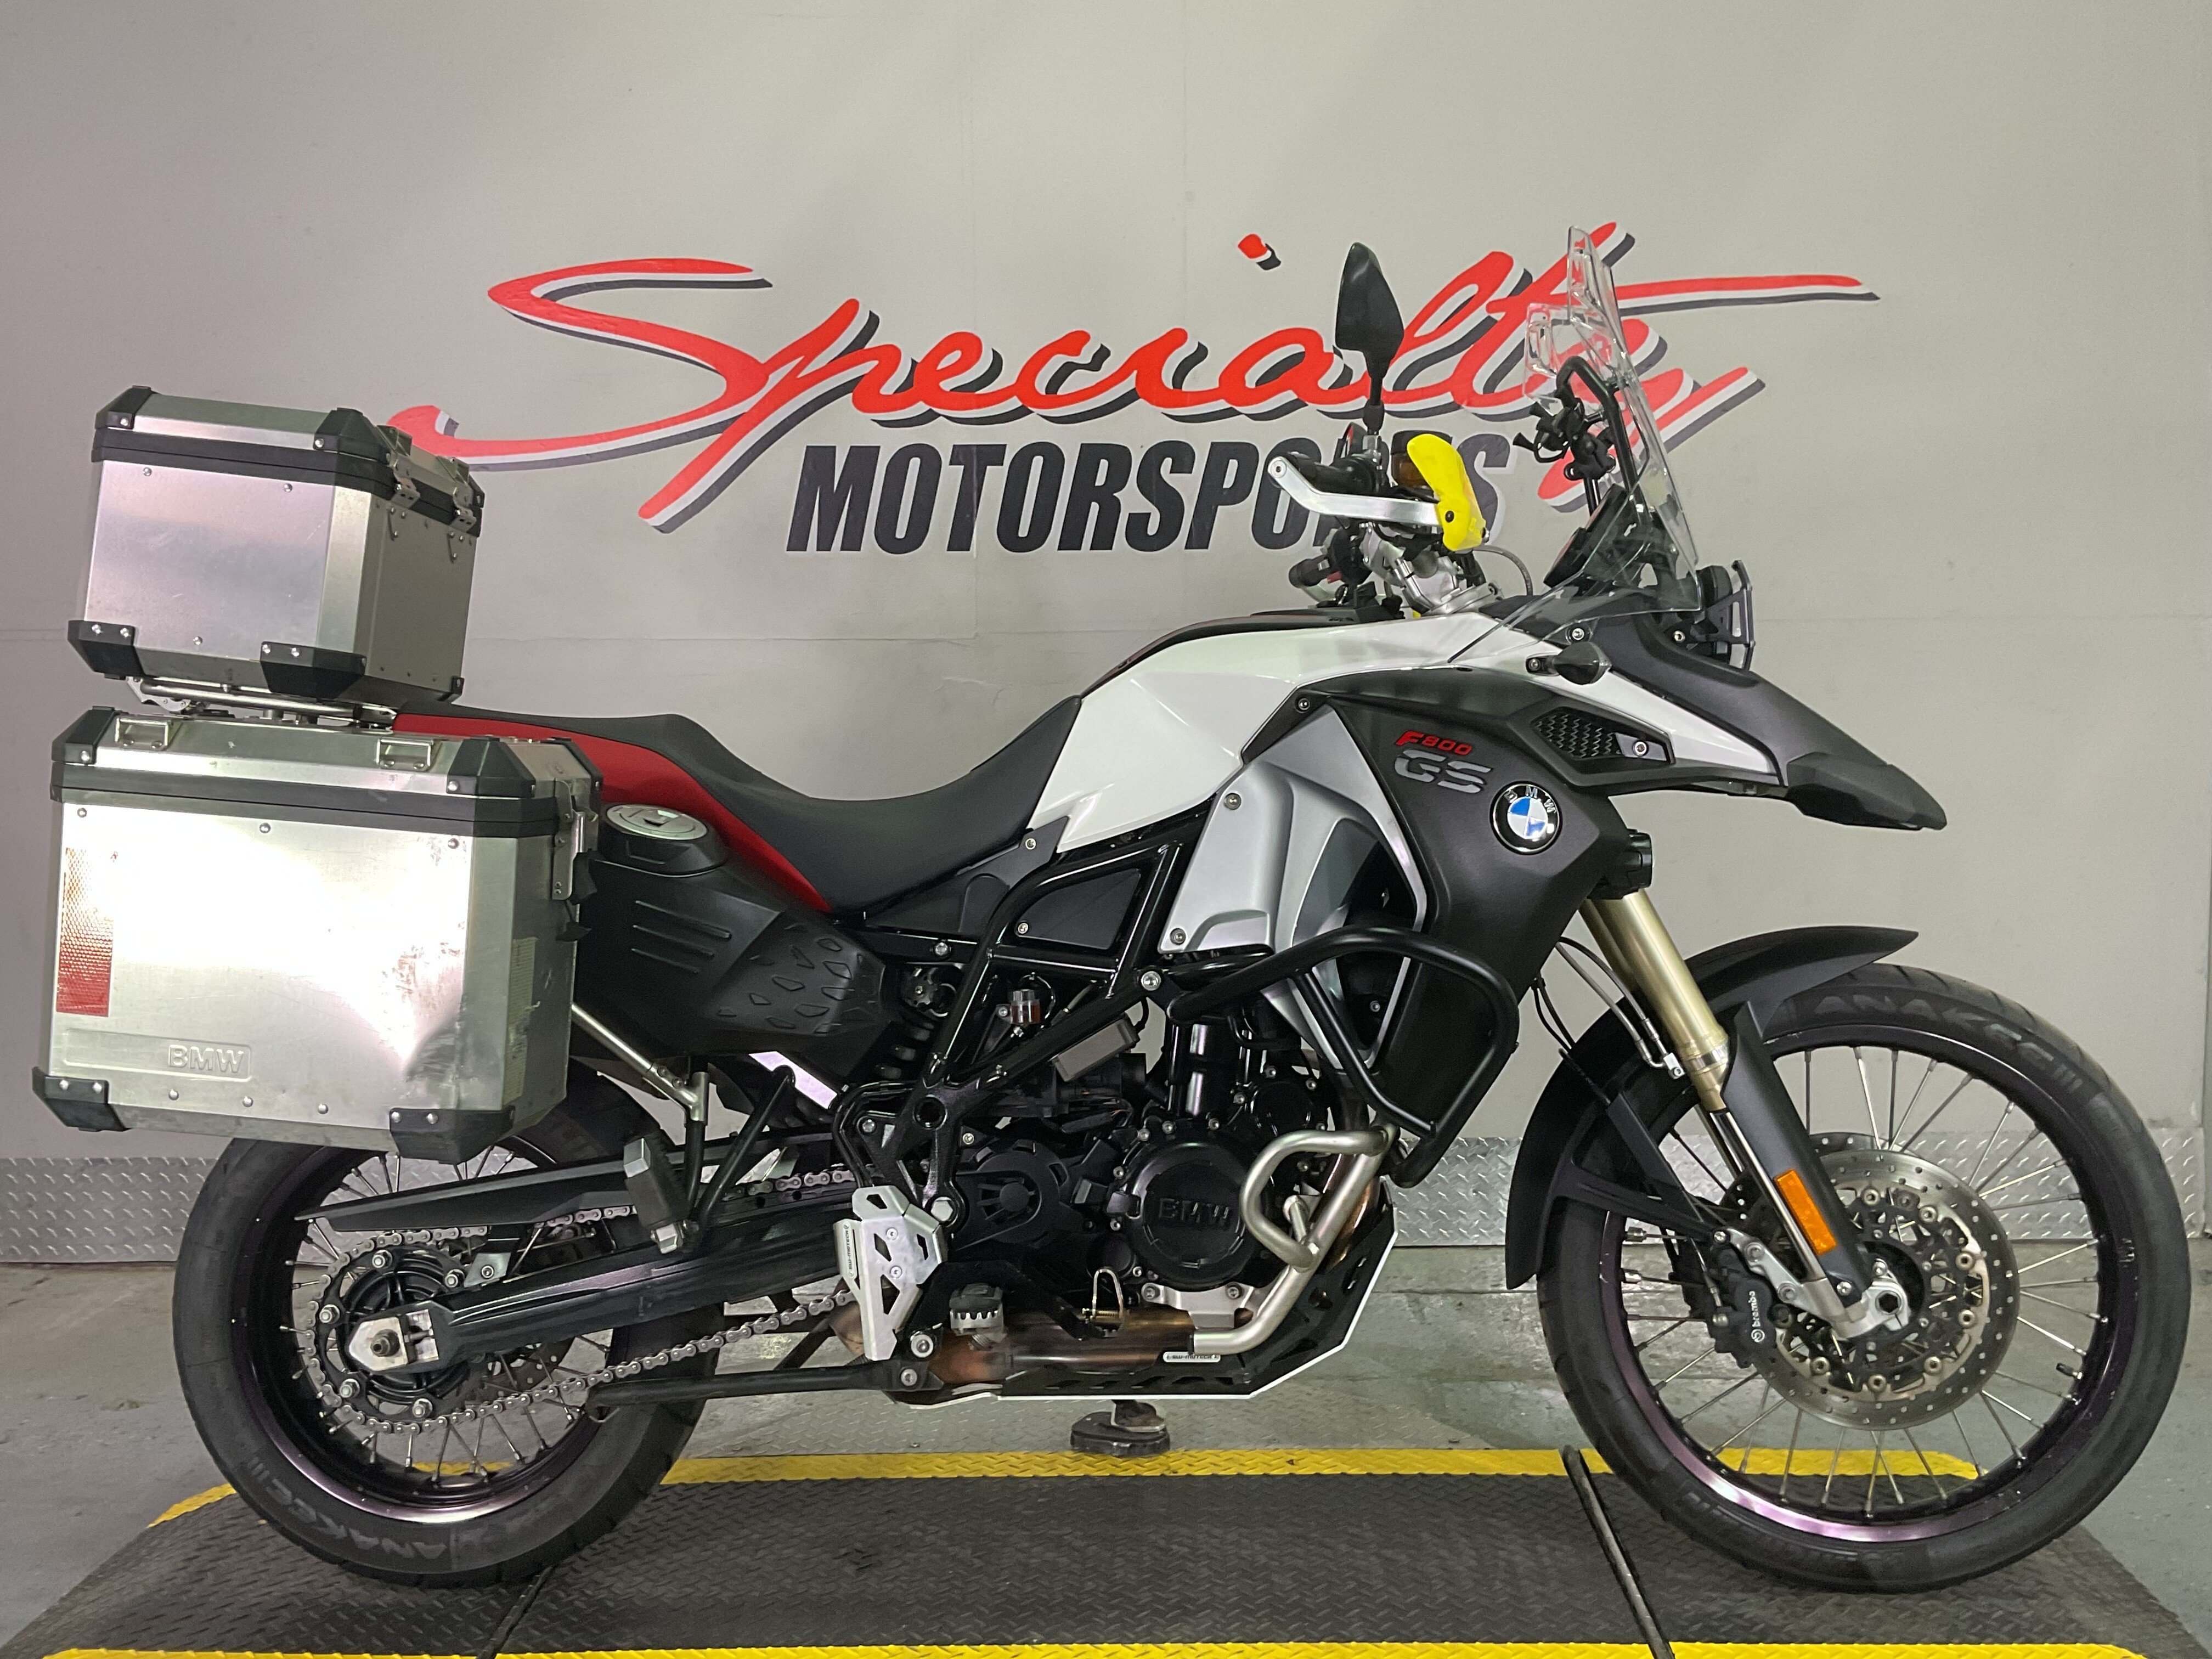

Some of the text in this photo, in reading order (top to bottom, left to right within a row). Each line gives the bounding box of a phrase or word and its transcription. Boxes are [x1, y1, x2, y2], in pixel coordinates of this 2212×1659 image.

[1395, 730, 1472, 755] F800
[1394, 749, 1491, 793] GS
[1504, 786, 1557, 814] BMW
[168, 1044, 244, 1074] BMW
